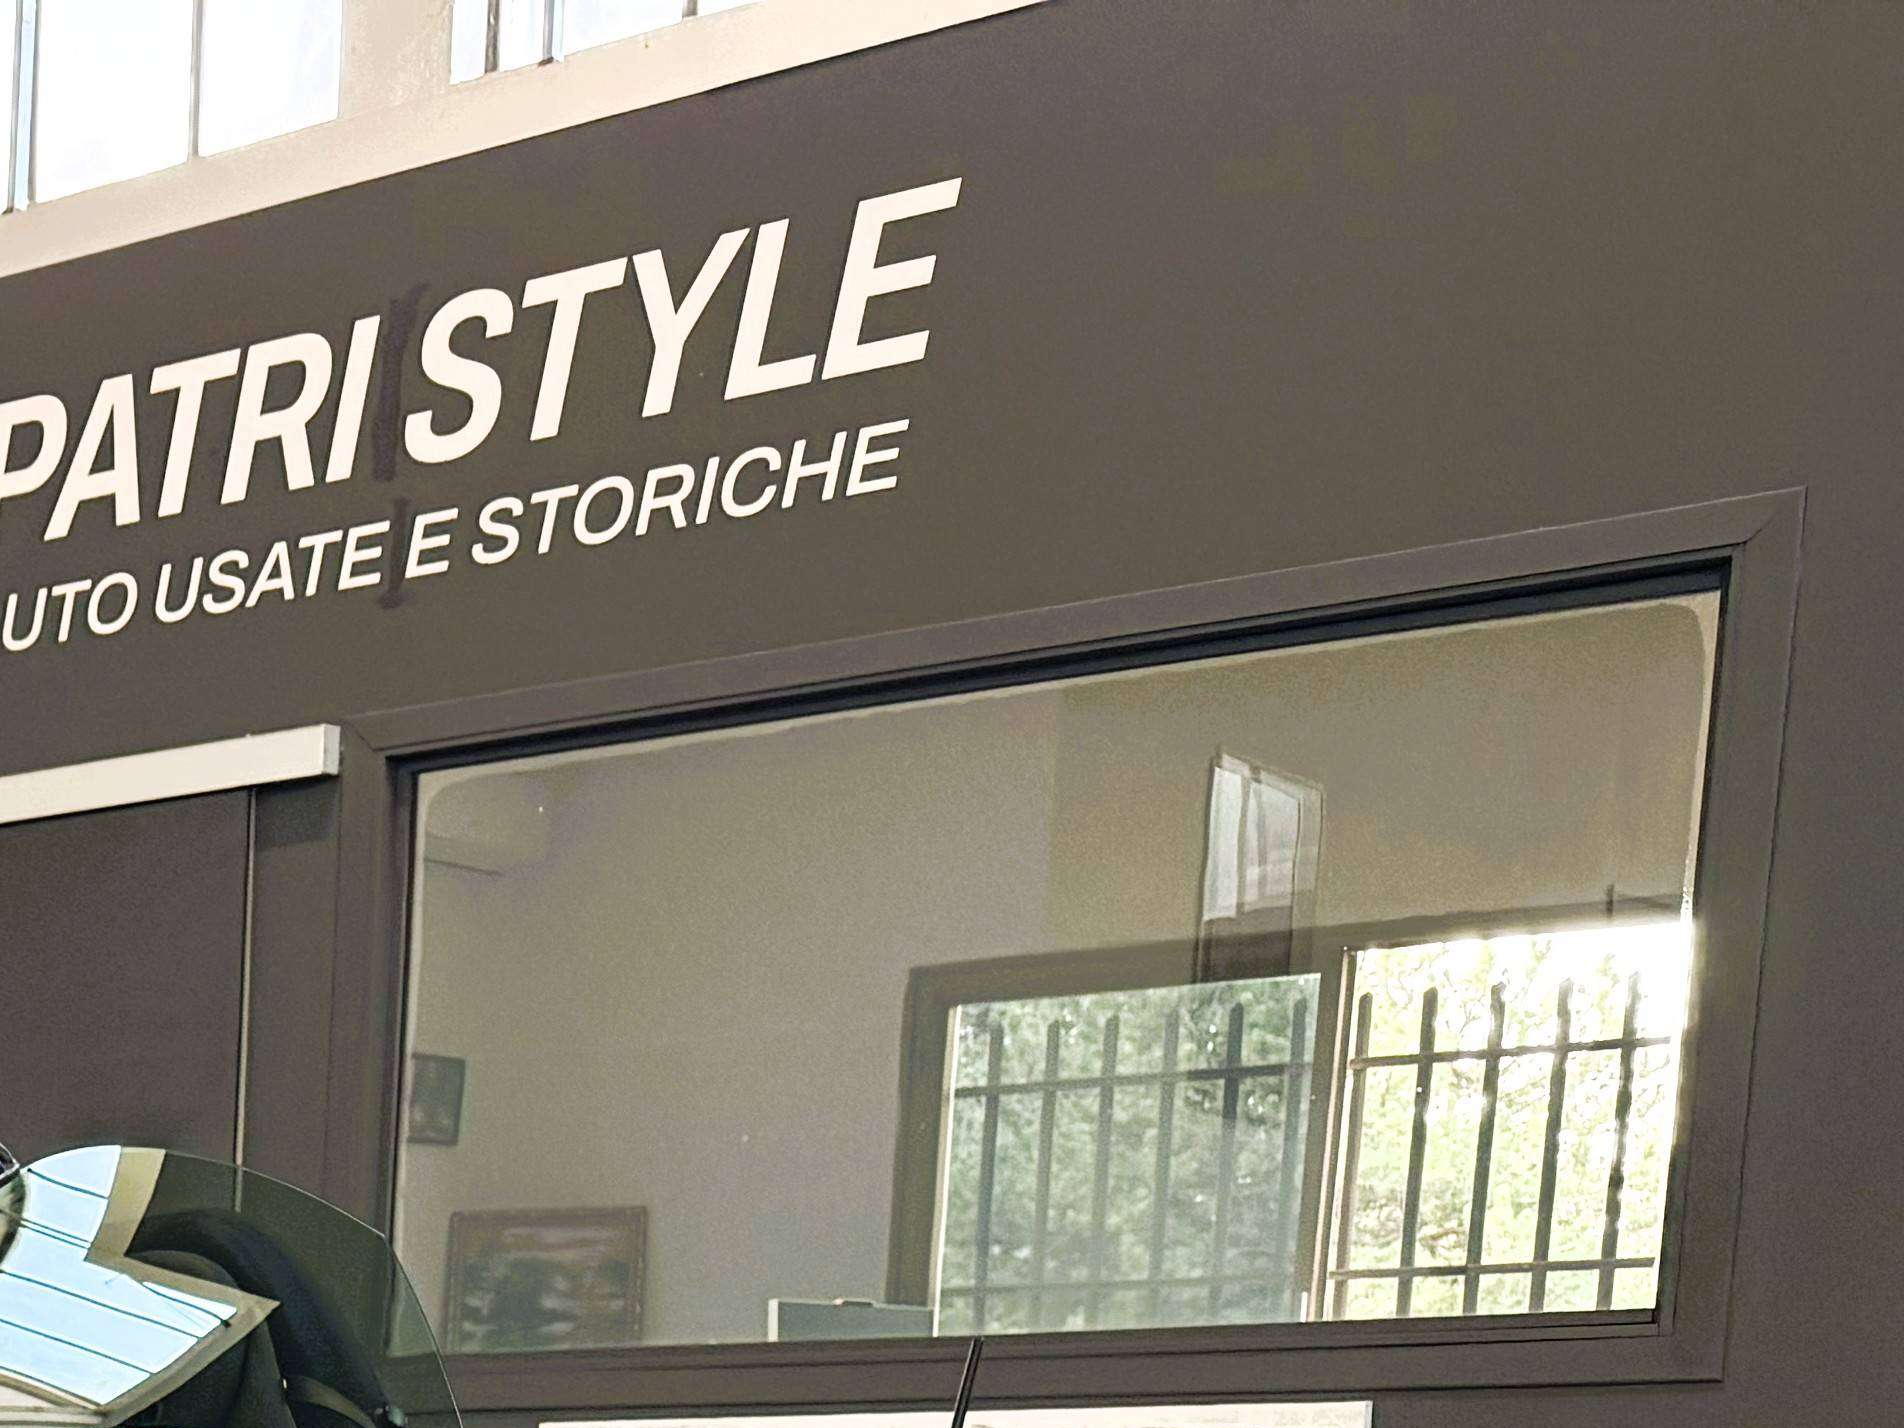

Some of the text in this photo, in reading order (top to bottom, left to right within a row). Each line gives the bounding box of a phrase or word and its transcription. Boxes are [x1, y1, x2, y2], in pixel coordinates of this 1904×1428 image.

[404, 177, 962, 463] STYLE
[155, 520, 391, 623] USATE
[404, 507, 459, 579] E
[471, 418, 910, 564] STORICHE
